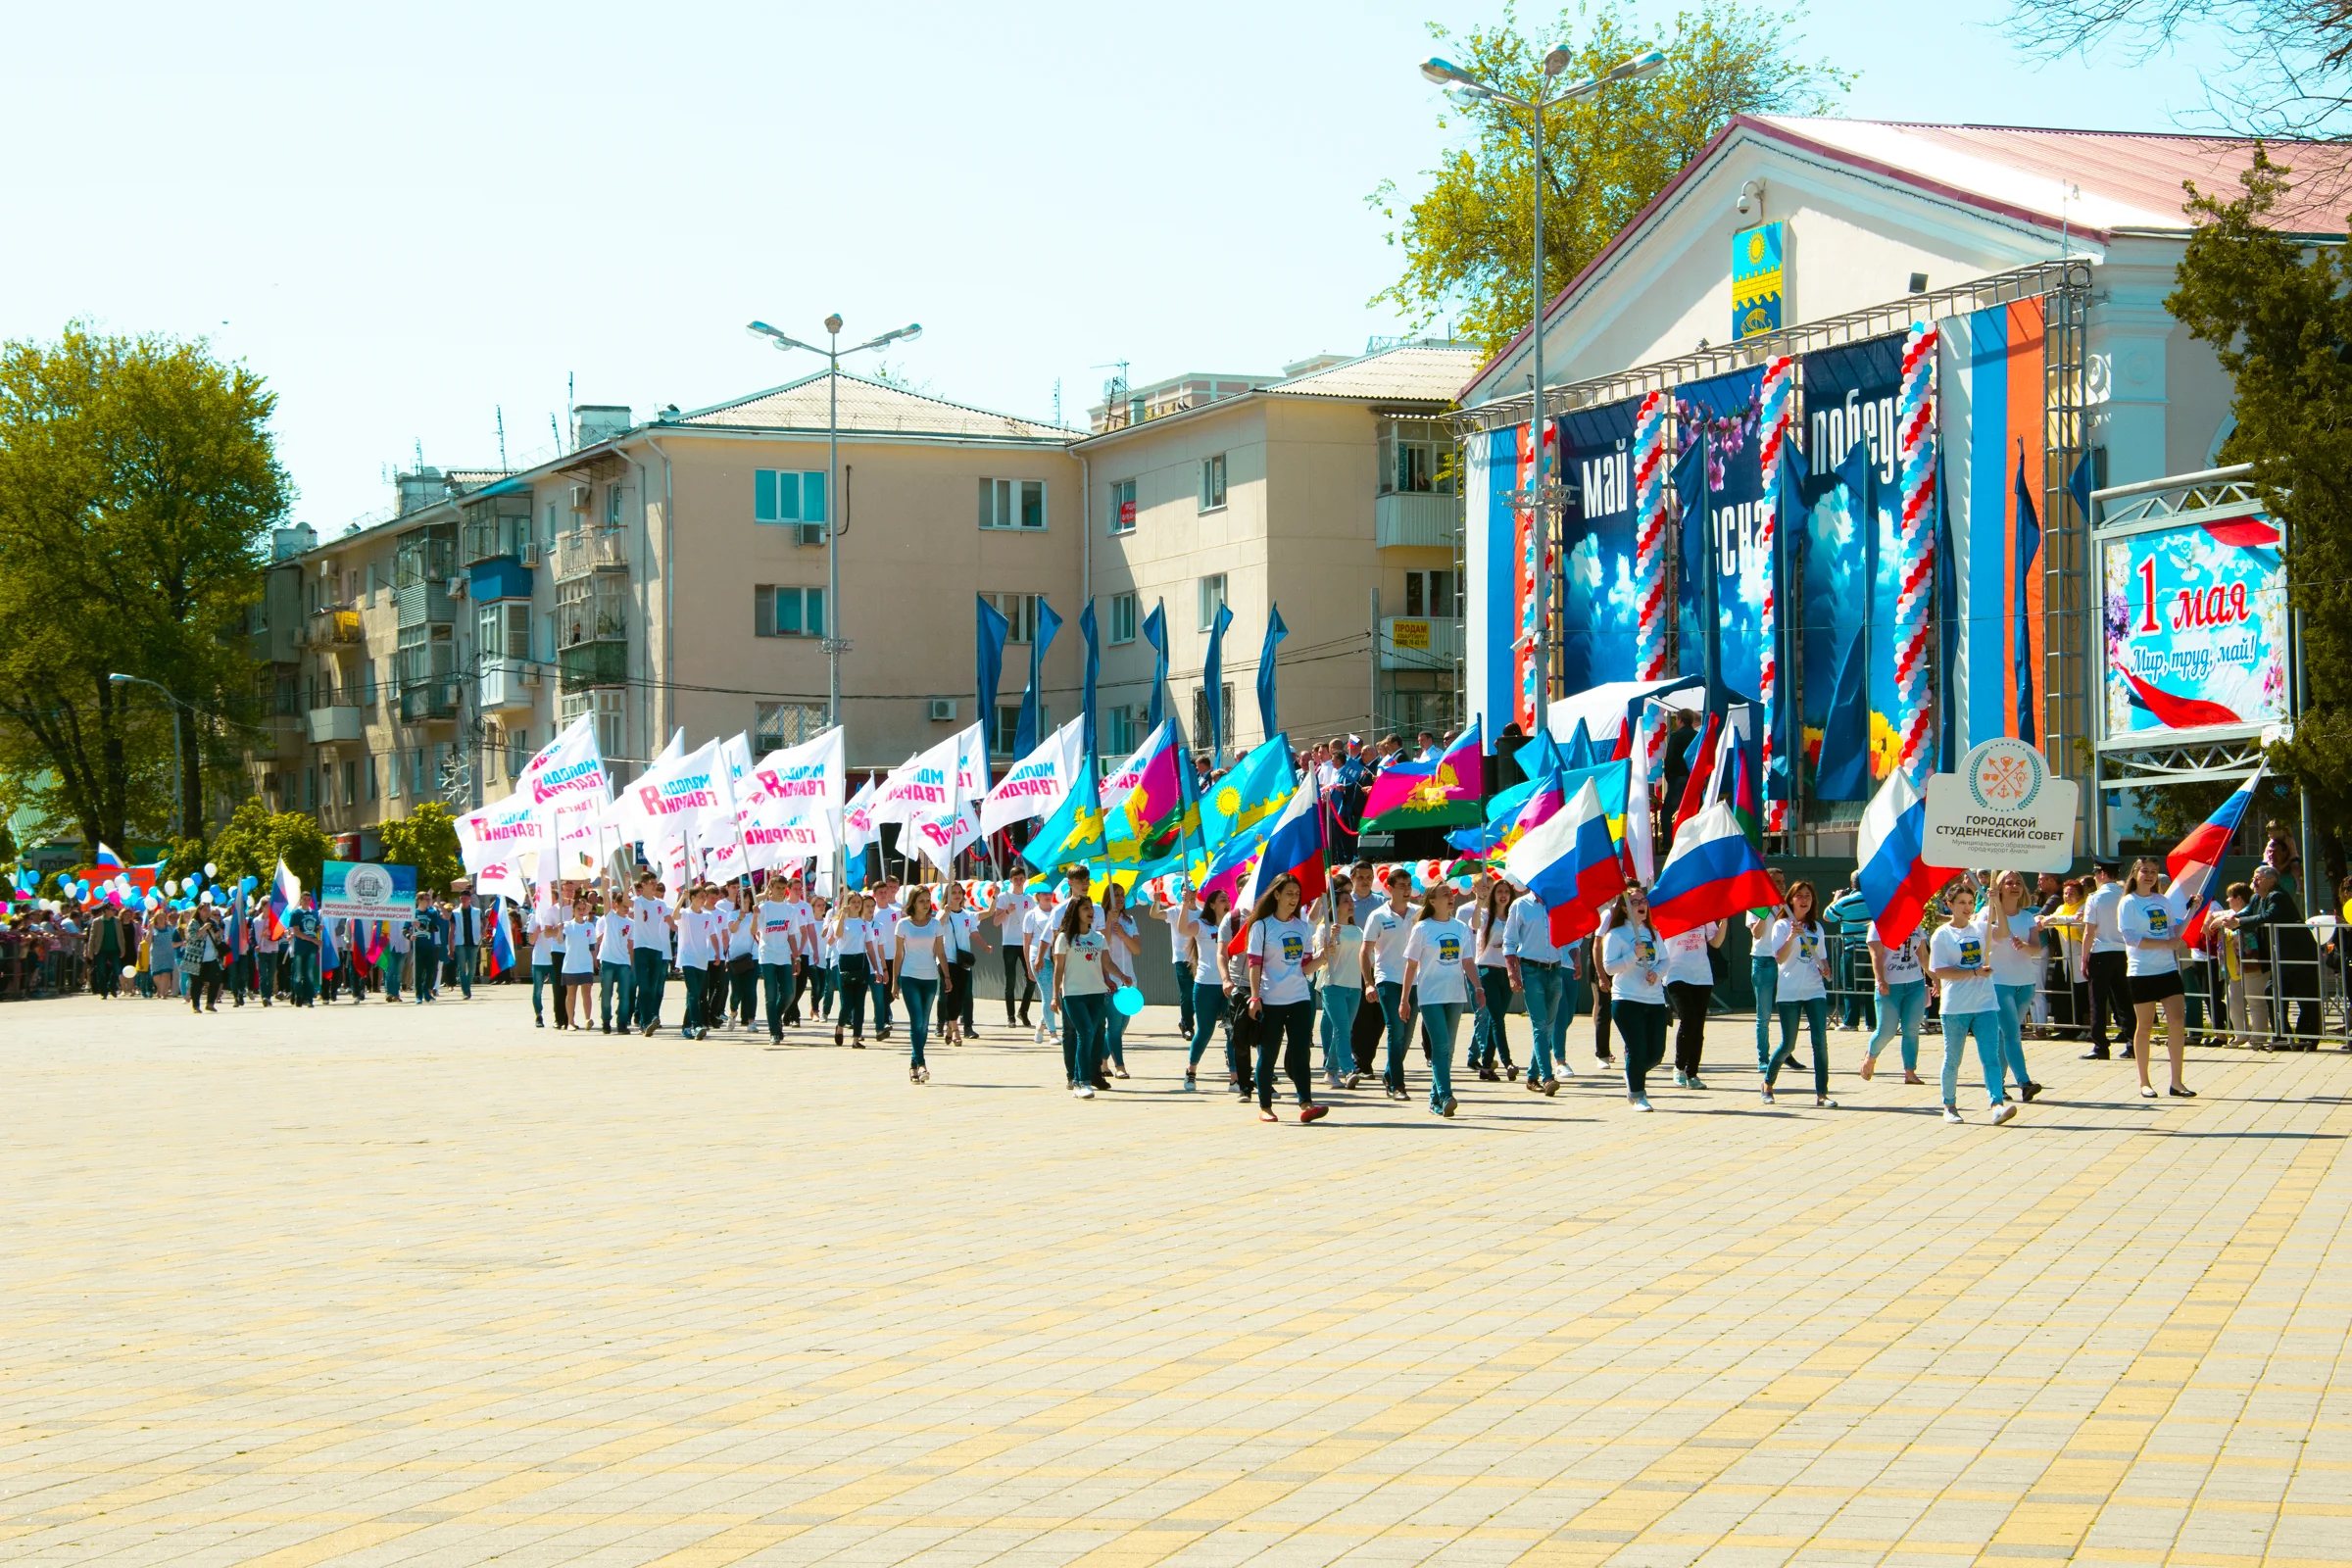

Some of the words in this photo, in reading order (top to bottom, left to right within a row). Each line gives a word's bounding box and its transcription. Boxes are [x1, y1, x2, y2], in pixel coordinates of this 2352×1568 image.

[1582, 437, 1628, 519] май
[1711, 498, 1766, 578] сна
[2138, 556, 2161, 634] 1
[2173, 582, 2252, 630] мая
[1395, 623, 1428, 634] ПРОДАМ
[2131, 648, 2168, 678] Мир,
[2171, 647, 2215, 679] труд,
[2217, 636, 2257, 662] май!
[1966, 814, 2036, 828] ГОРОДСКОЙ
[1936, 825, 2026, 840] СТУДЕНЧЕСКИЙ
[2028, 831, 2065, 842] СОВЕТ
[1951, 839, 2005, 849] Муниципального
[1967, 846, 2008, 855] город-курорт
